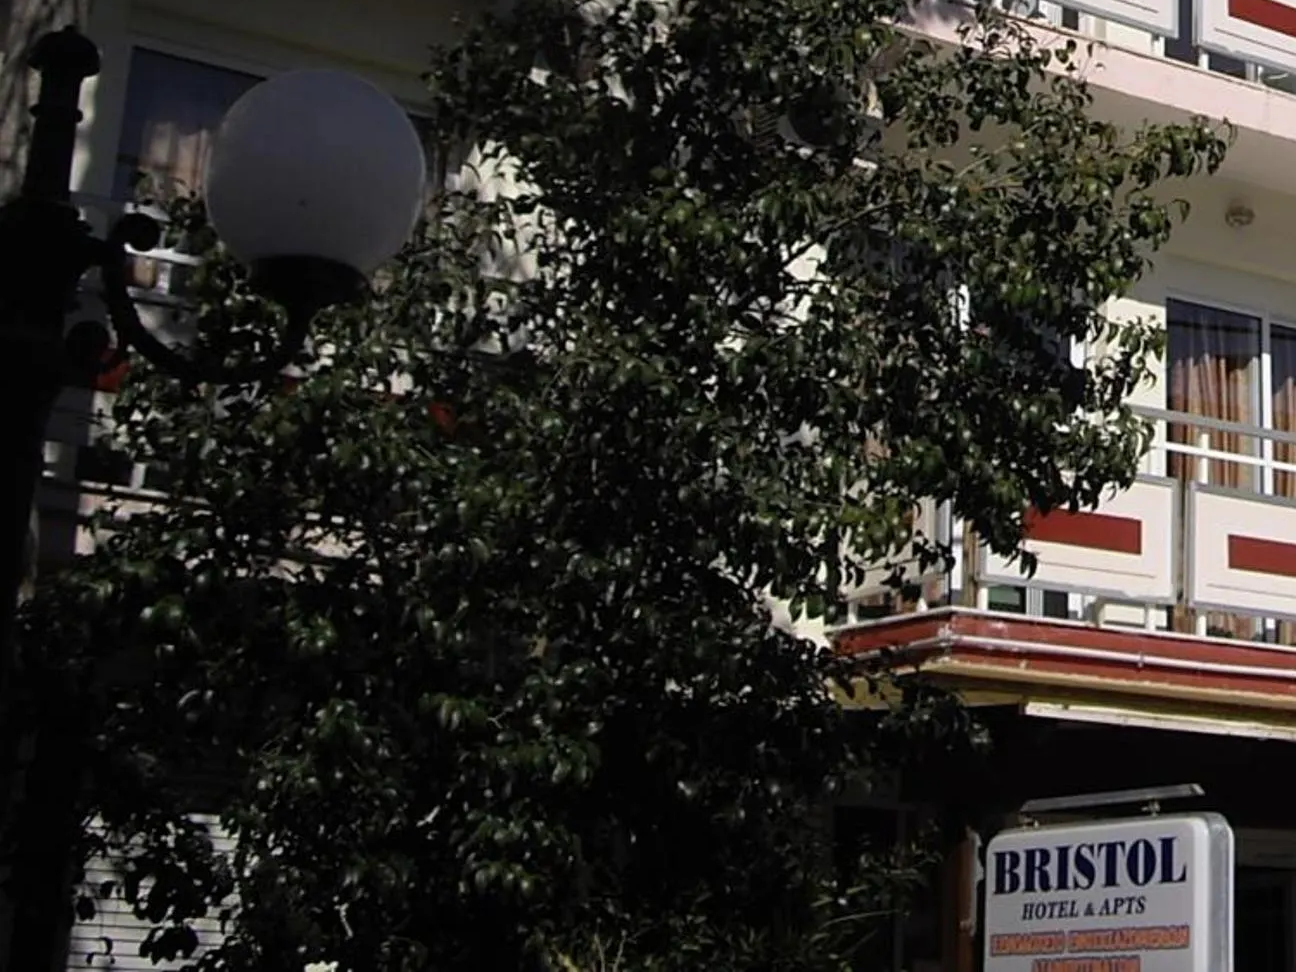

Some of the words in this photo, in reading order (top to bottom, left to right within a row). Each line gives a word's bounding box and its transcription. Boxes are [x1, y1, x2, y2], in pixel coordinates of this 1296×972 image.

[993, 836, 1187, 895] BRISTOL
[1021, 899, 1080, 920] HOTEL
[1083, 902, 1096, 916] &
[1098, 895, 1147, 916] APTS
